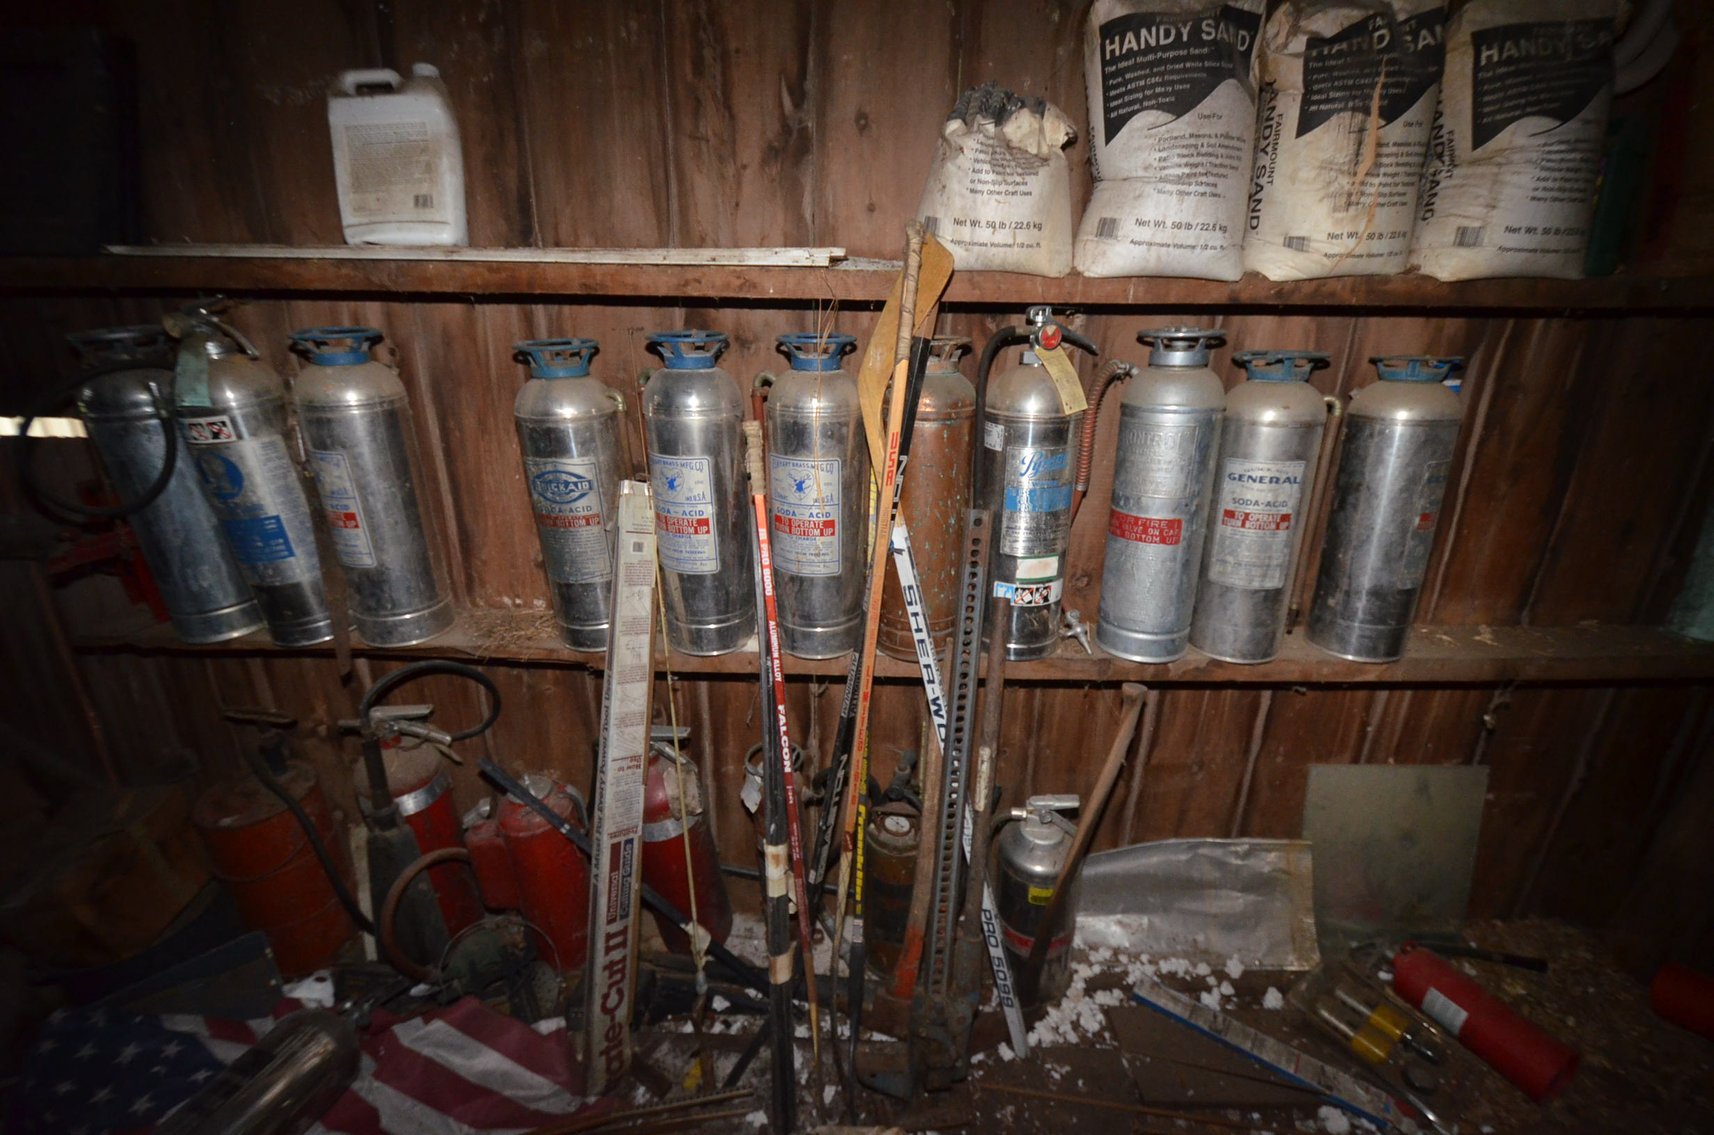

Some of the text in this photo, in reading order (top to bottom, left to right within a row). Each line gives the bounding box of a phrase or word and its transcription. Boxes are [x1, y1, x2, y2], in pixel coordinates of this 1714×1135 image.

[1104, 21, 1192, 60] HANDY
[1136, 49, 1189, 66] Multi-Purpose
[1189, 47, 1208, 56] Sand
[1267, 113, 1284, 186] FAIRMOUNT
[969, 188, 985, 196] Many
[1175, 189, 1192, 197] Other
[1193, 189, 1207, 197] Craft
[1249, 164, 1267, 231] SAND
[953, 217, 967, 227] Net
[970, 218, 983, 229] Wt.
[985, 220, 996, 229] 50
[998, 220, 1007, 230] lb
[1014, 221, 1032, 230] 22.6
[1033, 221, 1043, 231] kg
[1135, 217, 1150, 228] Net
[1153, 219, 1168, 230] Wt.
[1171, 221, 1182, 230] 50
[1184, 221, 1193, 230] lb
[1200, 222, 1217, 232] 22.6
[1218, 223, 1228, 233] kg
[1327, 232, 1343, 241] Net
[1365, 232, 1375, 241] 50
[886, 432, 899, 486] USA
[1227, 472, 1301, 485] GENERAL
[1231, 497, 1289, 508] SODA-ACID
[568, 505, 592, 514] ACID
[681, 509, 705, 517] ACID
[776, 507, 831, 519] SODA ACID
[1234, 511, 1245, 520] TO
[589, 517, 600, 525] UP
[666, 517, 698, 527] OPERATE
[791, 518, 824, 529] OPERATE
[1138, 518, 1168, 529] FIRE
[668, 526, 708, 534] BOTTOM UP
[792, 527, 821, 536] BOTTOM
[823, 528, 834, 536] UP
[1148, 527, 1160, 535] ON
[773, 659, 782, 682] ALLOY
[902, 585, 947, 744] SHER-WO
[777, 703, 791, 773] FALCON
[593, 836, 601, 870] Must
[599, 736, 608, 775] Power
[622, 843, 632, 876] Guide
[608, 871, 619, 921] Universal
[982, 909, 1014, 1008] PRO 5099
[600, 955, 628, 1078] ate-Cut
